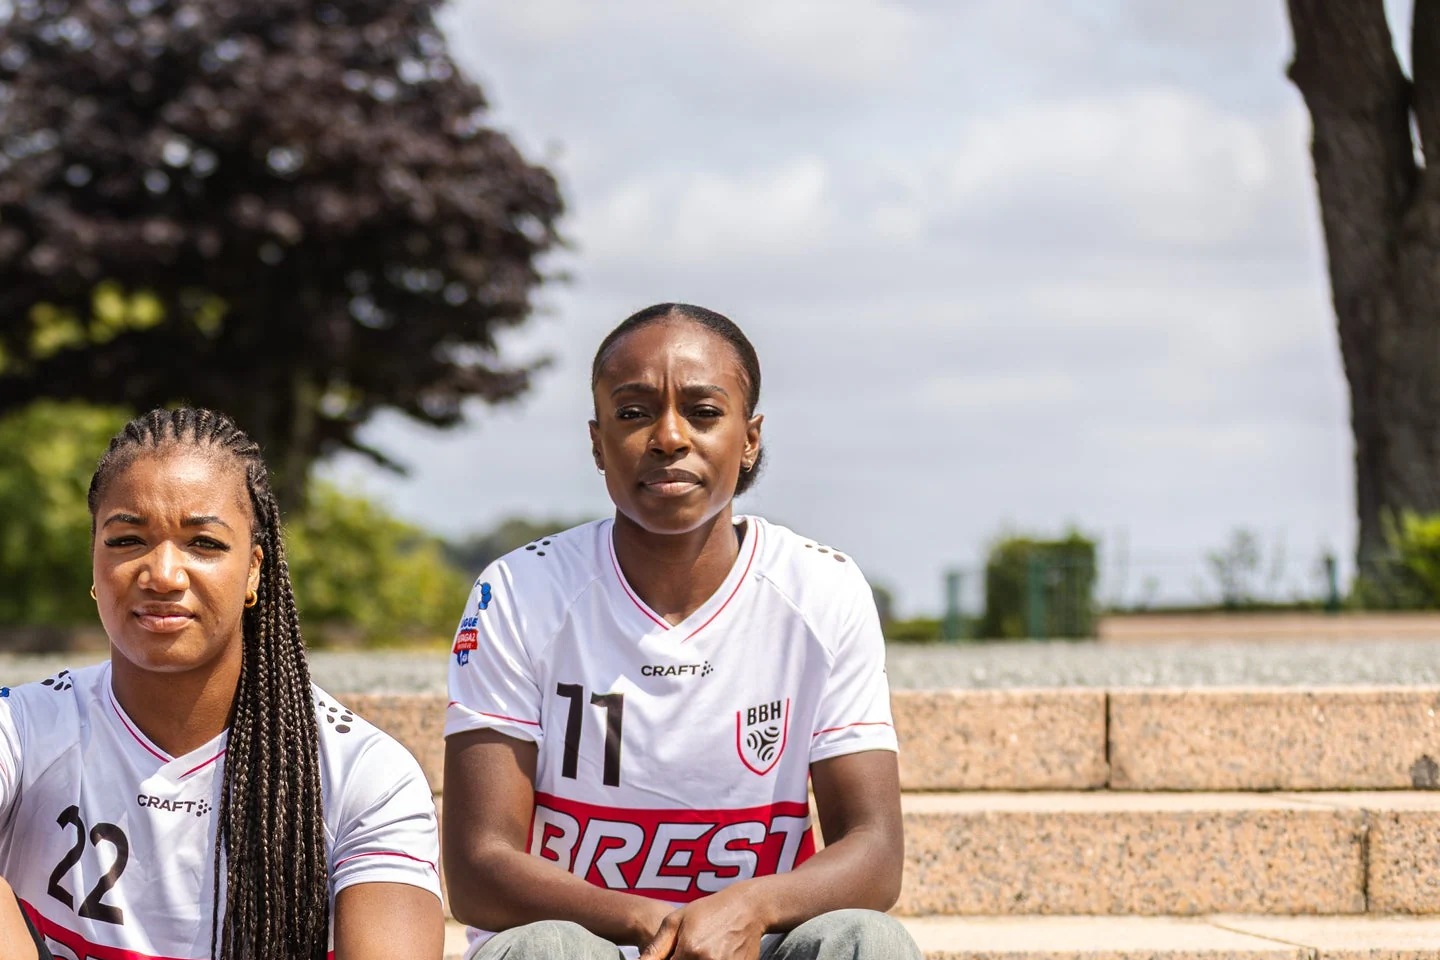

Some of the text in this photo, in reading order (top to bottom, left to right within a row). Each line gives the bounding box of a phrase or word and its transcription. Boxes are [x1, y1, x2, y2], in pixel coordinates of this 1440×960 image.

[640, 664, 700, 676] CRAFT
[556, 682, 625, 787] 11
[747, 700, 781, 726] BBH
[137, 794, 196, 813] CRAFT
[47, 805, 129, 925] 22
[530, 803, 811, 893] BREST
